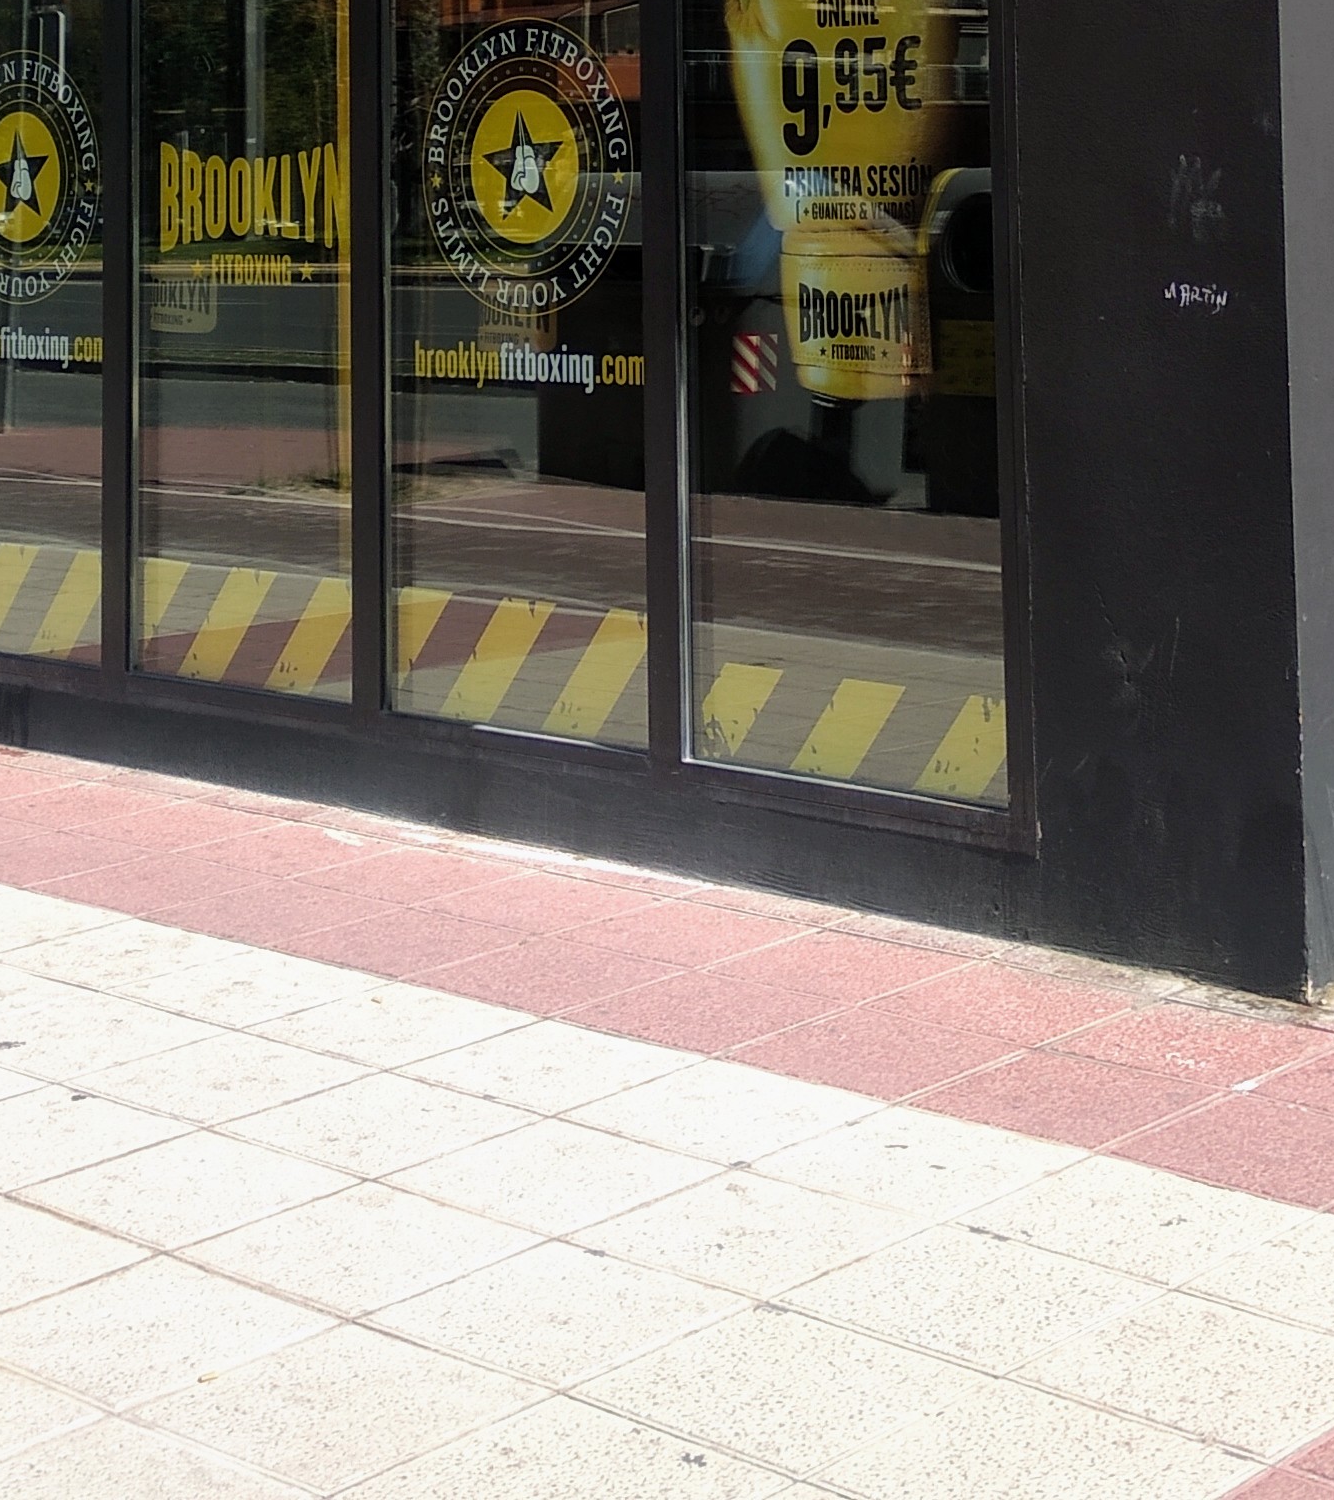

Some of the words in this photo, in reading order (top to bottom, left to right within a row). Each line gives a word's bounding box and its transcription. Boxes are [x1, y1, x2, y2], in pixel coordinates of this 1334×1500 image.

[21, 59, 96, 172] FITBOXING
[429, 29, 517, 165] BROOKLYN
[526, 28, 628, 160] FITBOXING
[781, 34, 922, 157] 9,95€
[160, 141, 343, 254] BROOKLYN
[784, 166, 863, 198] PRIMERA
[866, 157, 933, 198] SESIÓN
[812, 202, 857, 221] GUANTES
[860, 202, 868, 220] &
[55, 198, 94, 281] FIGHT
[211, 254, 292, 286] FITBOXING
[431, 196, 491, 294] LIMITS
[573, 191, 625, 290] FIGHT
[496, 276, 567, 309] YOUR
[798, 282, 909, 344] BROOKLYN
[414, 339, 645, 394] brooklynfitboxing.com
[831, 344, 876, 361] FITBOXING
